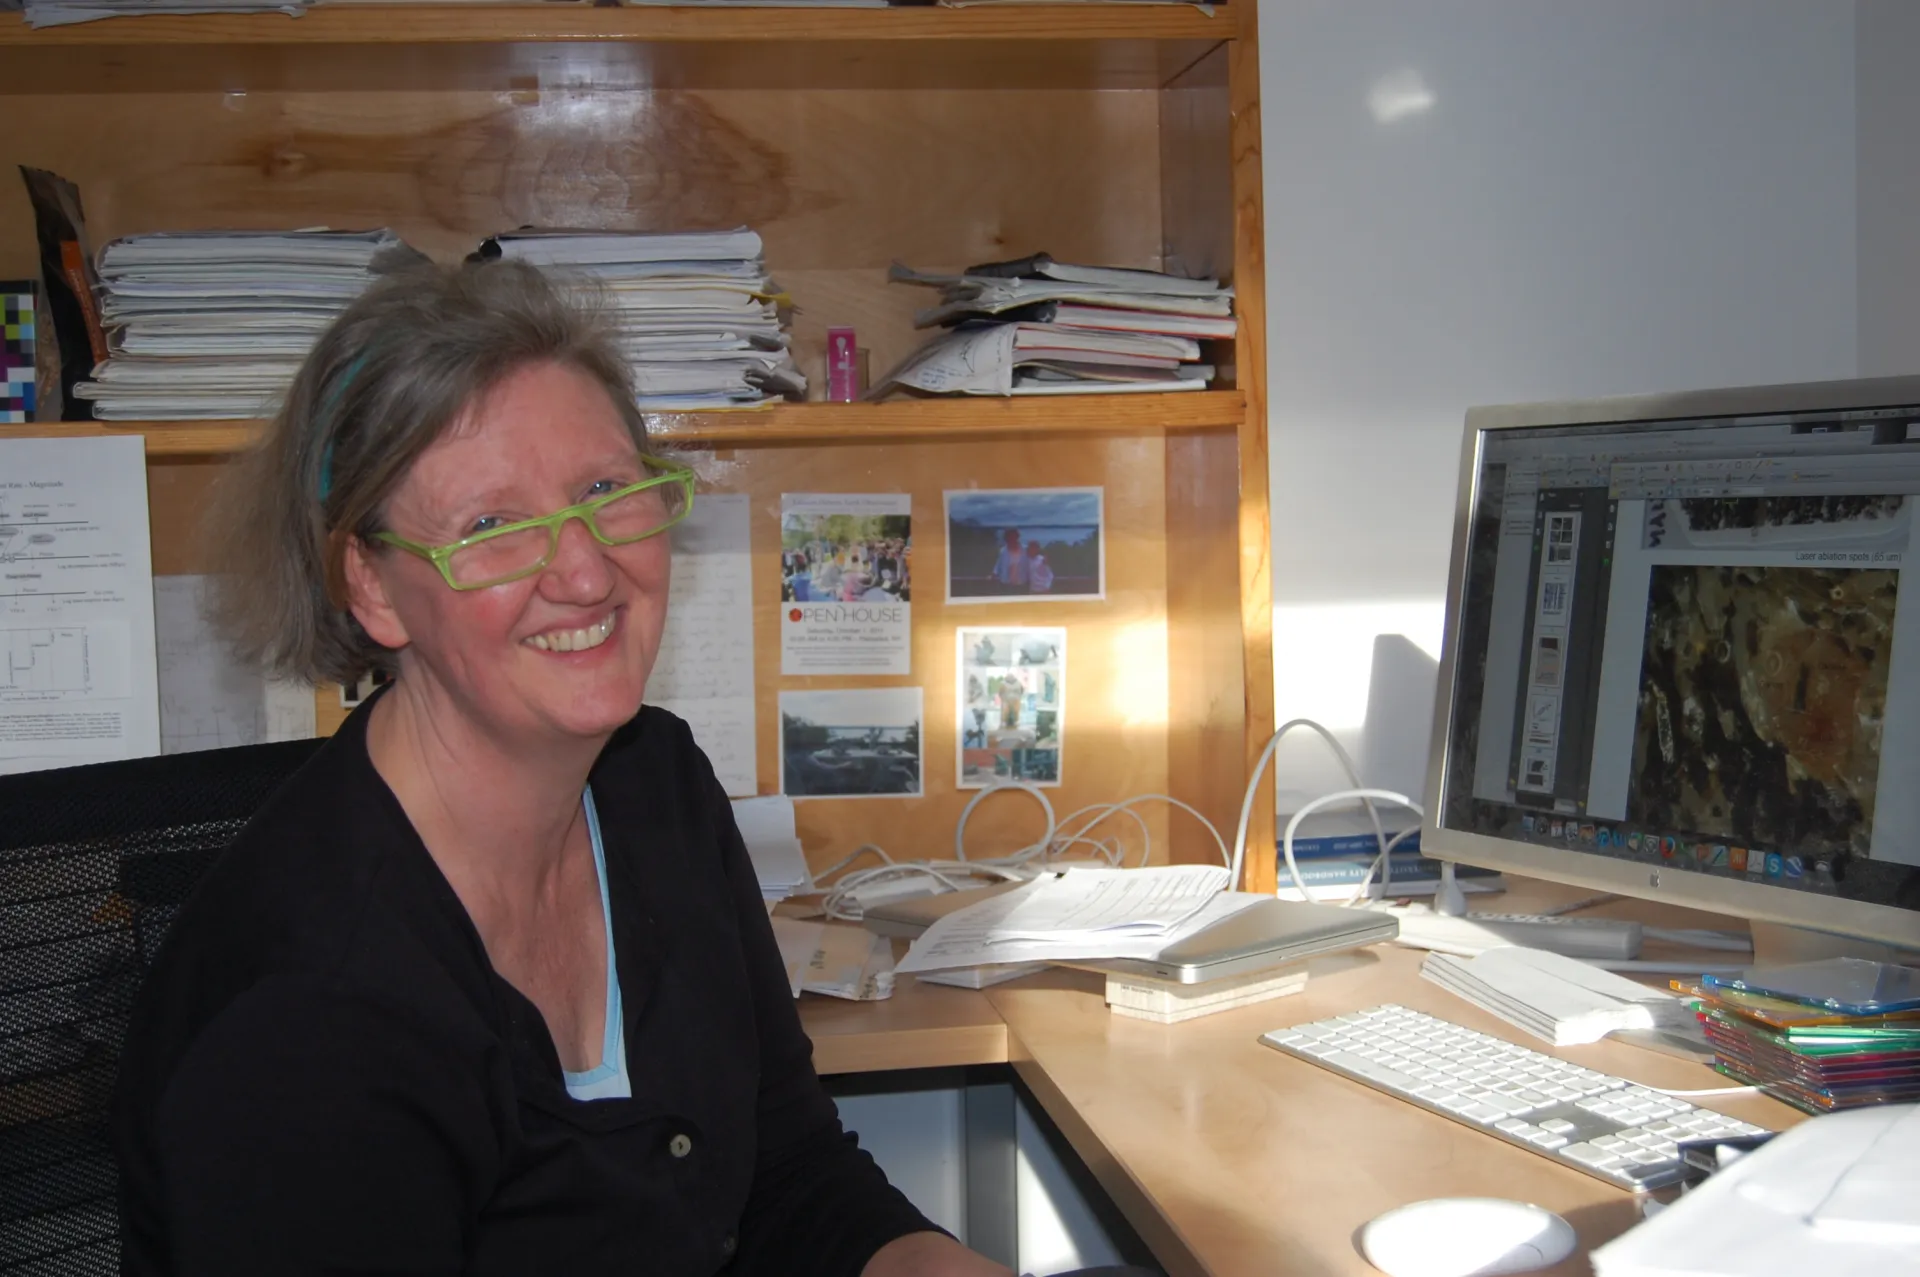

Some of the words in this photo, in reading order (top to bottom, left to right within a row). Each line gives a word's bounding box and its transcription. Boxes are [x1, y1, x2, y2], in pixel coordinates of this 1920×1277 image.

[1796, 551, 1816, 561] Laser
[1818, 551, 1847, 561] ablation
[1849, 552, 1869, 563] spots
[842, 607, 903, 623] HOUSE
[1299, 869, 1347, 880] HANDBOO
